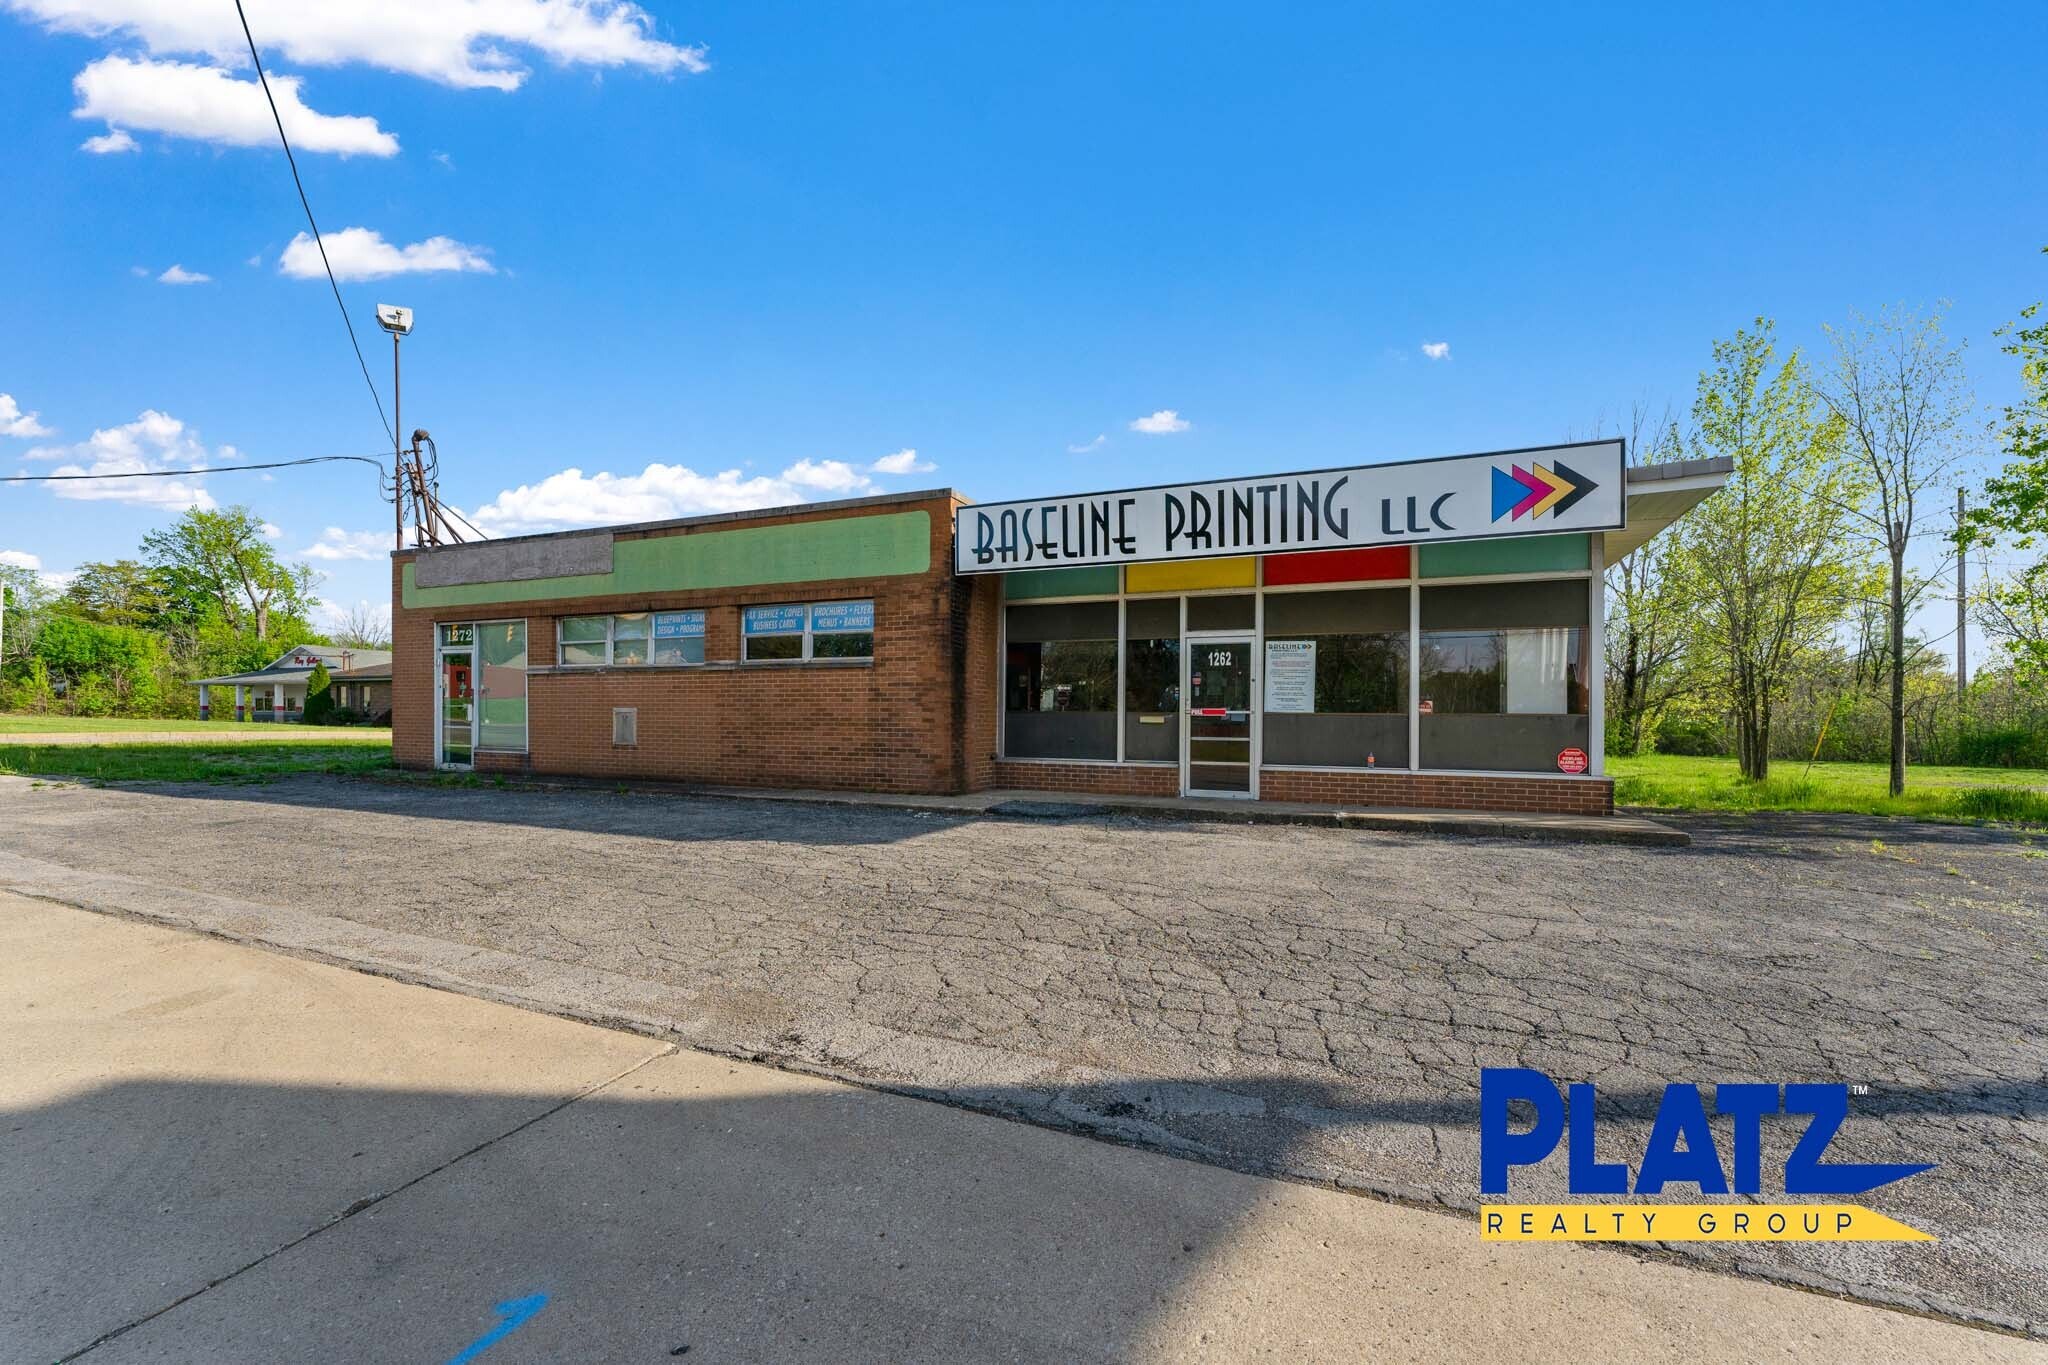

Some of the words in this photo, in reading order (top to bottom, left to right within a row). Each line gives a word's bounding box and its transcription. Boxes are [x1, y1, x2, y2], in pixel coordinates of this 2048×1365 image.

[972, 499, 1136, 565] BASELINE
[1165, 475, 1349, 552] PRINTING
[1381, 492, 1457, 535] LLC
[758, 609, 778, 618] SERVICE
[784, 607, 804, 617] COPIES
[815, 606, 848, 616] BROCHURES
[753, 620, 778, 630] BUSINESS
[780, 618, 797, 629] CARDS
[818, 618, 838, 628] MENUS
[844, 616, 870, 626] BANNERS
[447, 629, 473, 641] 1272
[1208, 651, 1232, 666] 1262
